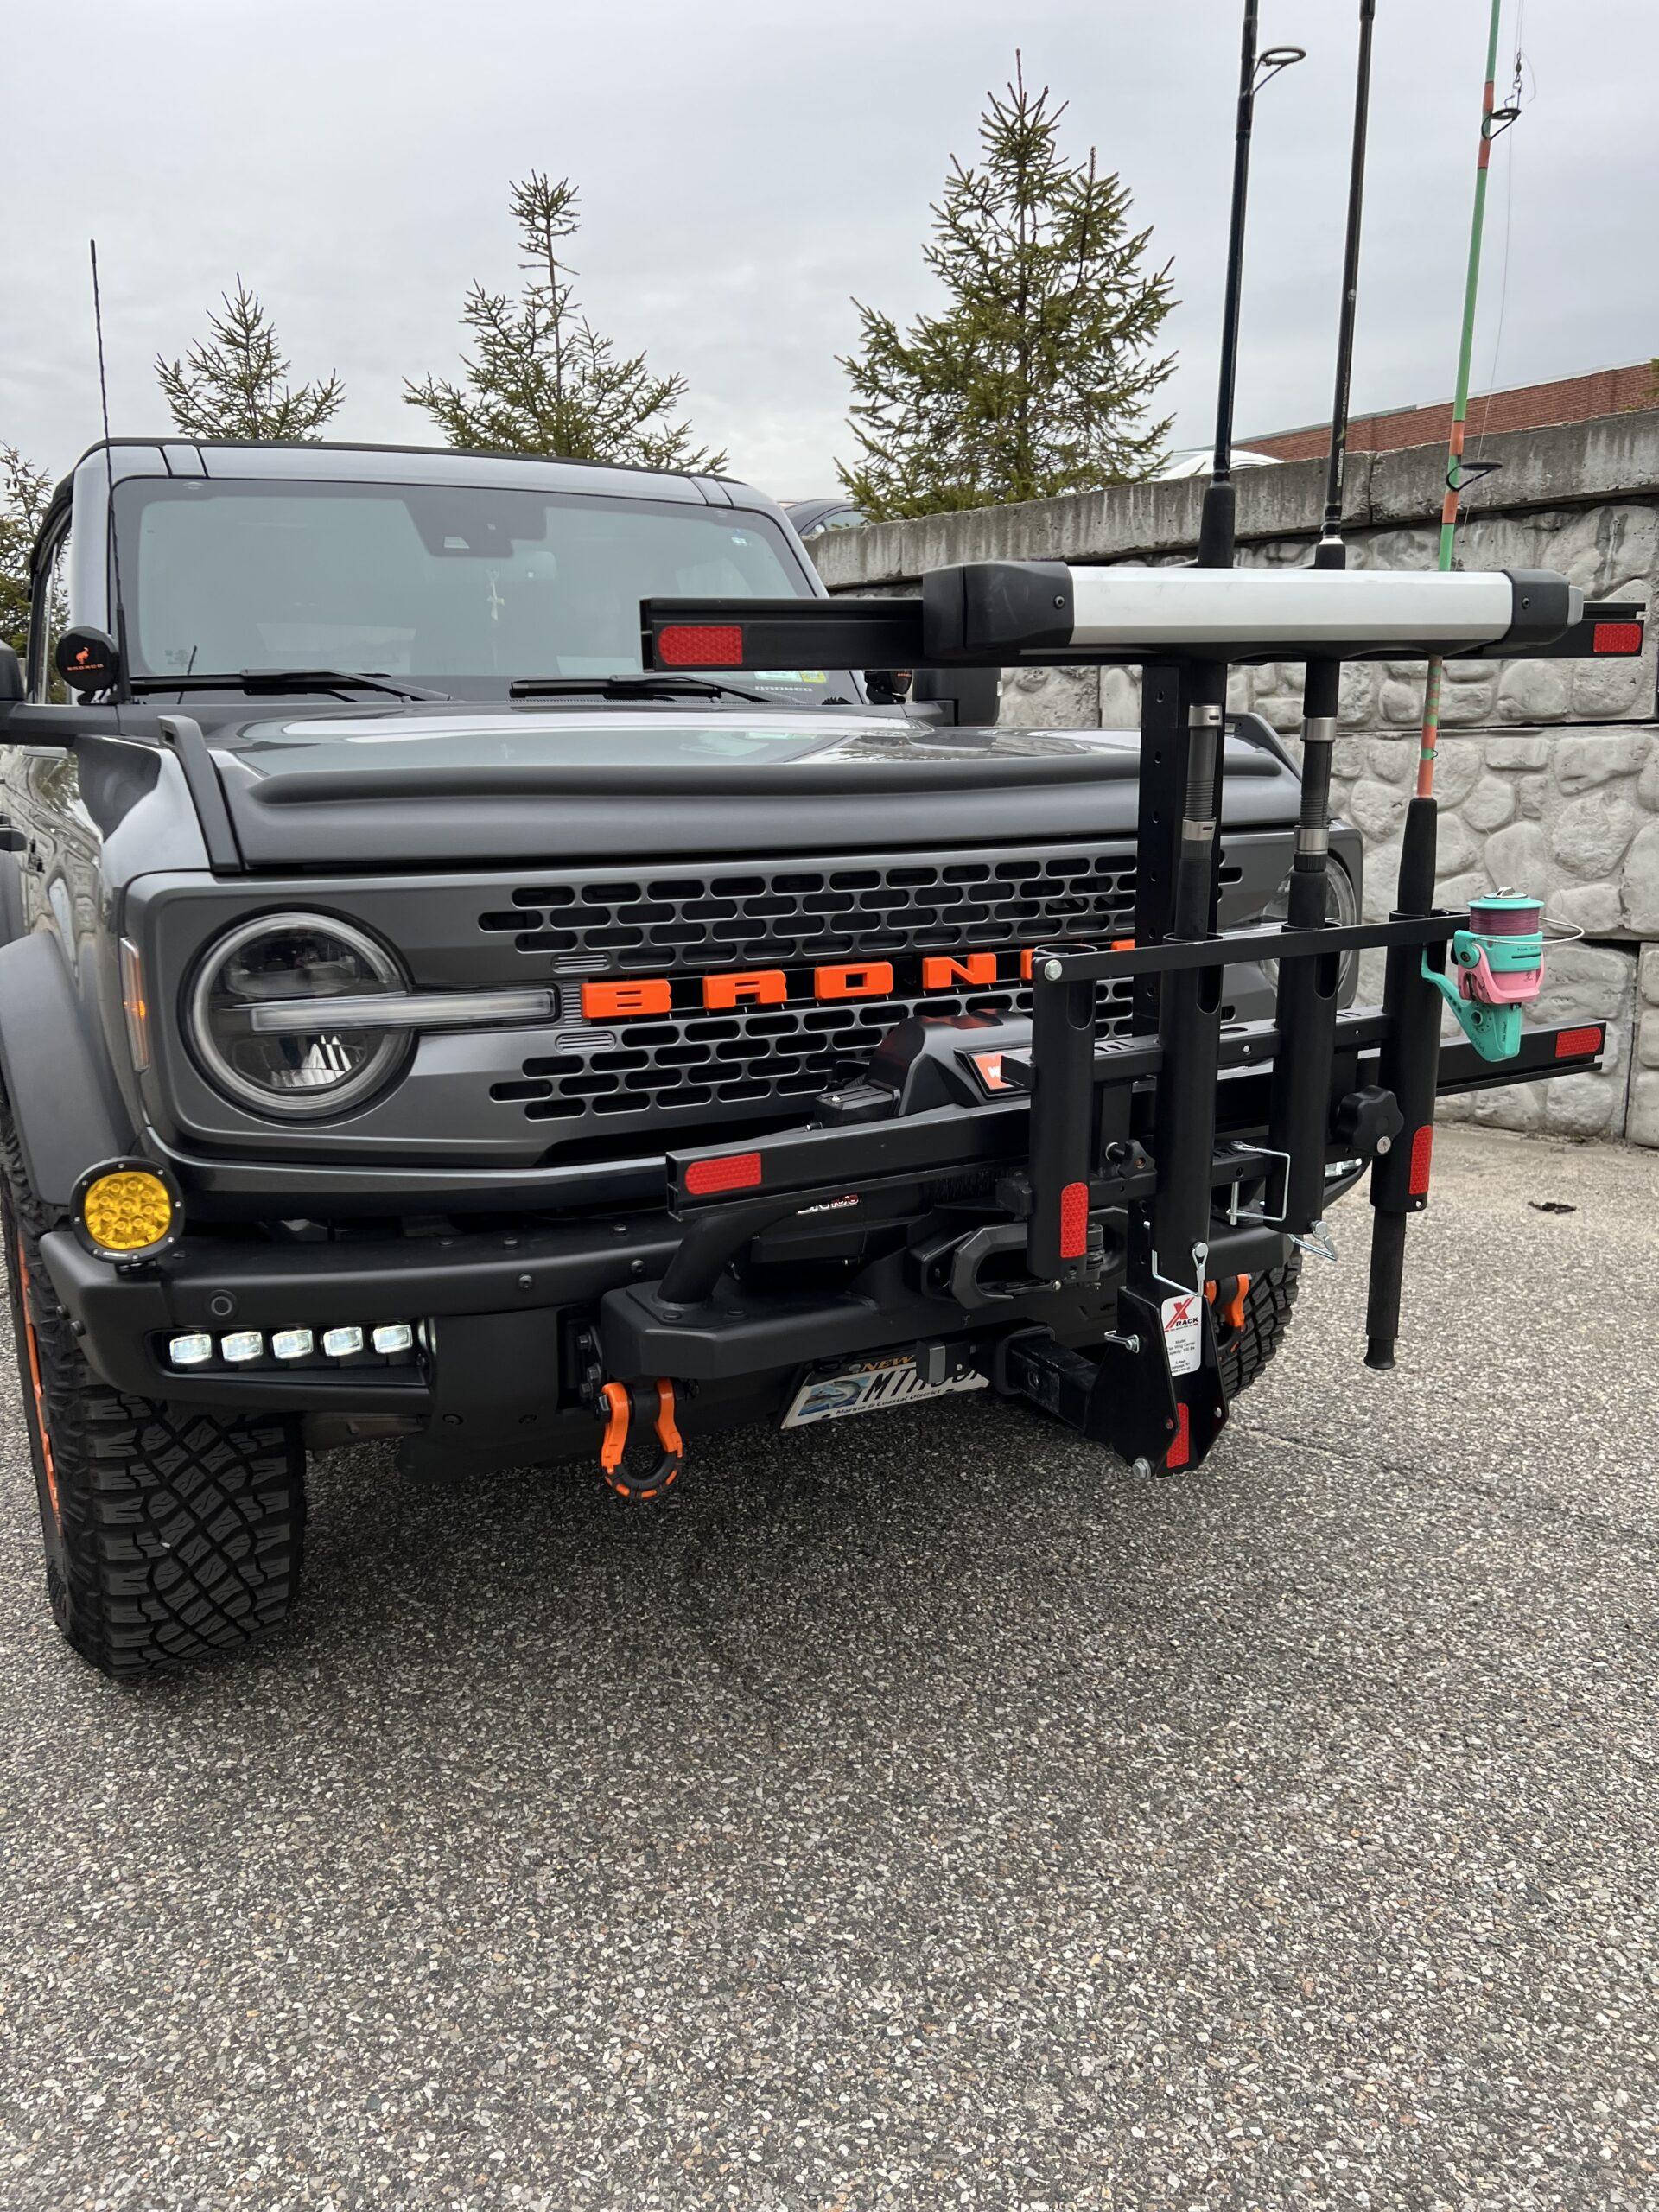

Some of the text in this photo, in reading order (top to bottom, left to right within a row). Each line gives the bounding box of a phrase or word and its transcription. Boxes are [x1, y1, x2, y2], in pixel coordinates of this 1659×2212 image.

[1336, 448, 1344, 487] SHIMANO
[581, 938, 1135, 1020] BRON
[1175, 1317, 1199, 1327] RACK
[861, 1354, 916, 1372] NEW
[836, 1405, 866, 1415] Marine
[877, 1396, 908, 1407] Coastal
[909, 1389, 942, 1400] District
